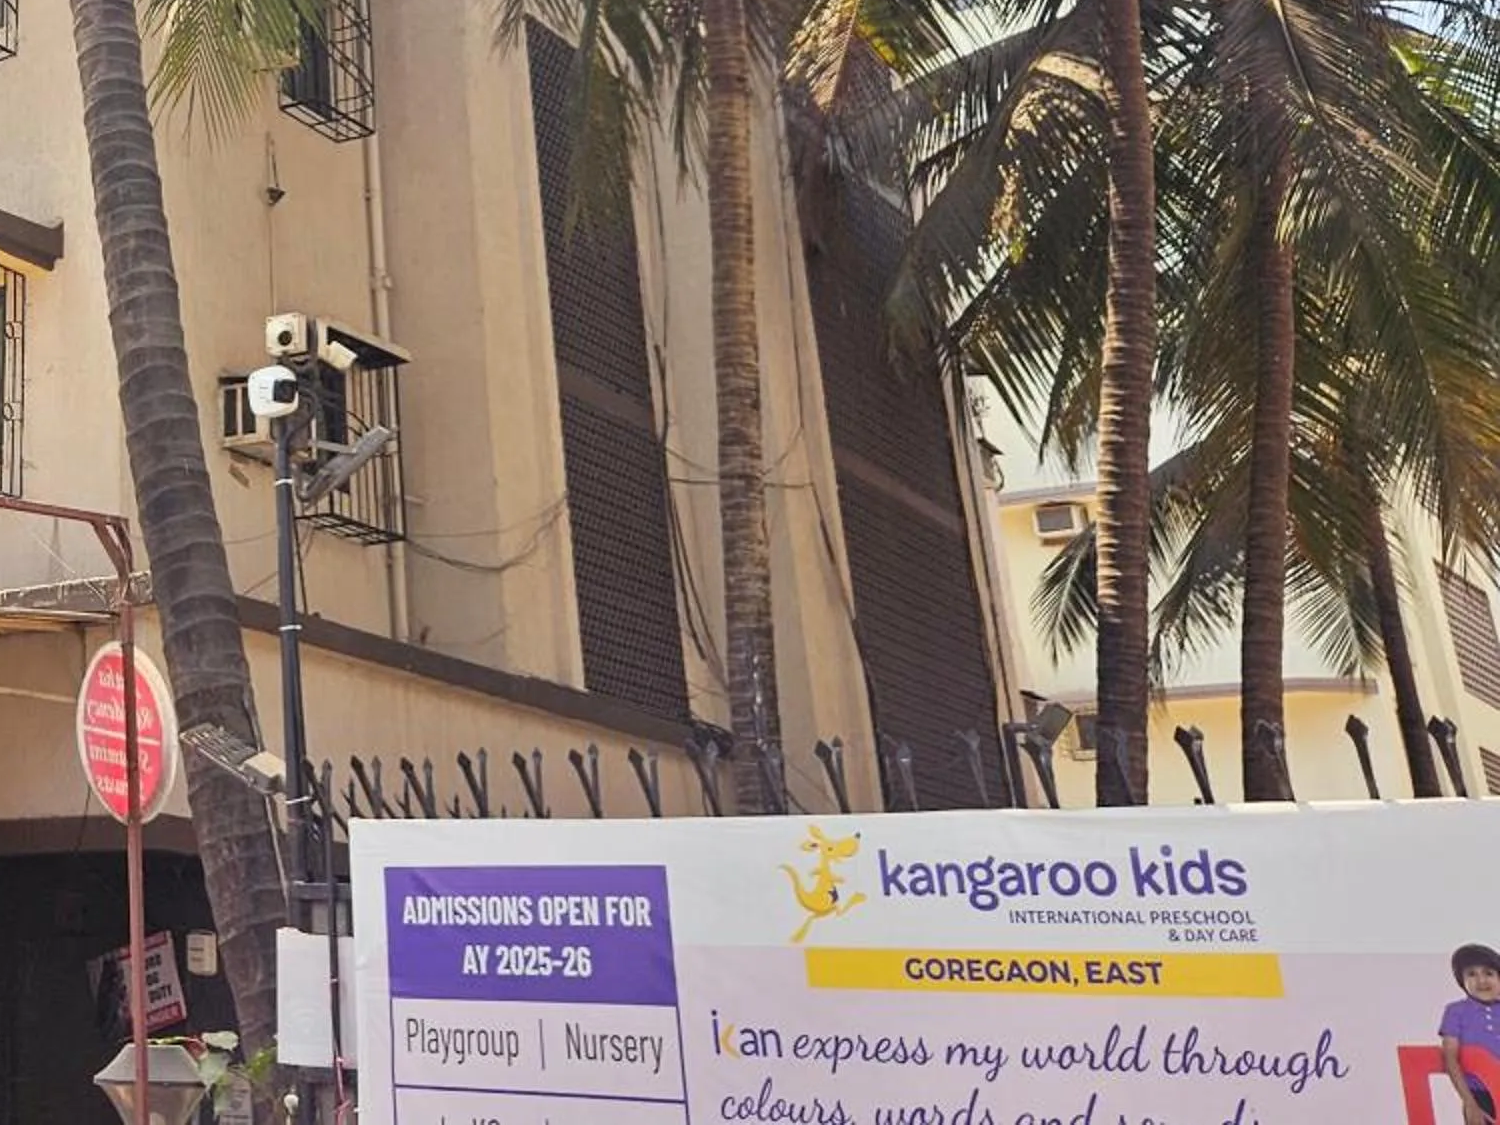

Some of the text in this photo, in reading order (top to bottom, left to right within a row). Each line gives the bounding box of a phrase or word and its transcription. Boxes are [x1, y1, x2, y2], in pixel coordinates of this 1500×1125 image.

[879, 845, 1249, 912] kangaroo kids
[403, 895, 652, 927] ADMISSIONS OPEN FOR
[1008, 909, 1256, 927] INTERNATIONAL PRESCHOOL
[1168, 928, 1259, 943] & DAY CARE
[462, 945, 593, 978] AY 2025-26
[904, 956, 1163, 988] GOREGAON, EAST
[406, 1017, 664, 1075] Playgroup Nursery
[792, 1031, 934, 1076] express
[945, 1041, 1010, 1083] my
[1021, 1023, 1151, 1073] world
[1163, 1026, 1350, 1096] through
